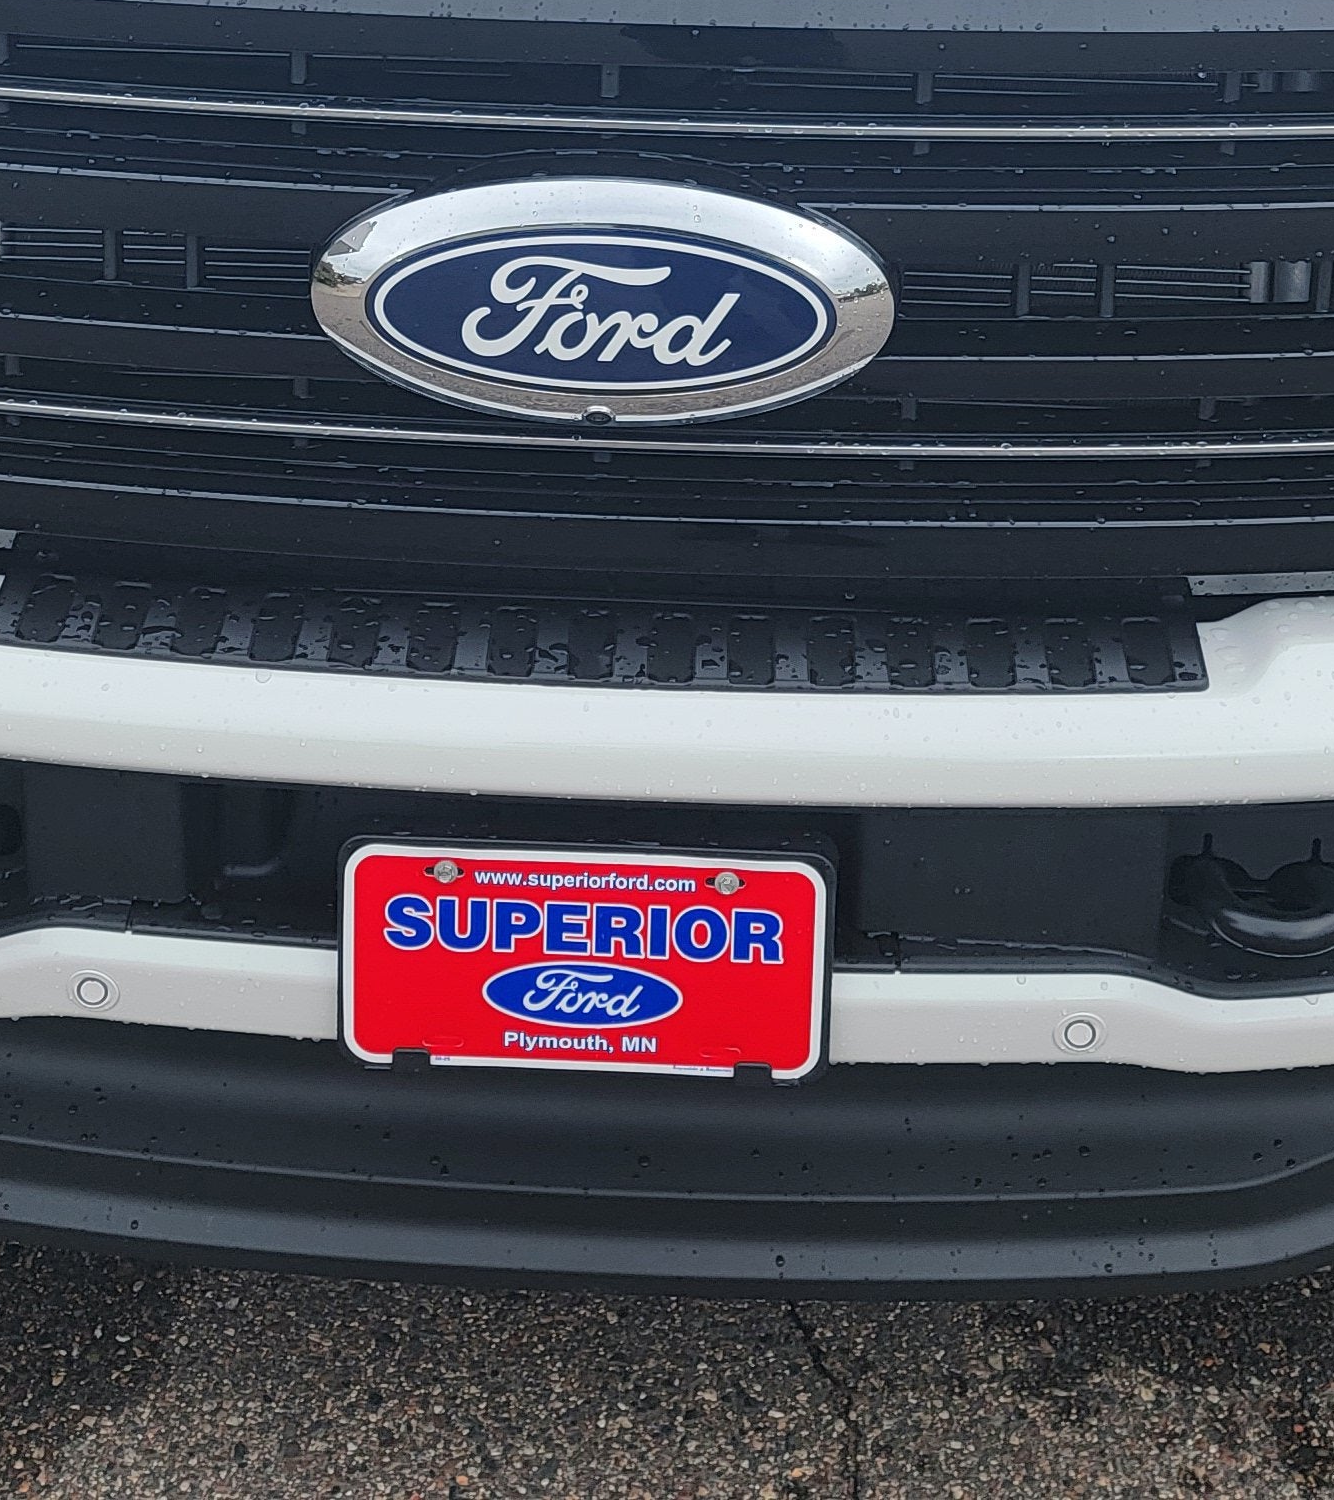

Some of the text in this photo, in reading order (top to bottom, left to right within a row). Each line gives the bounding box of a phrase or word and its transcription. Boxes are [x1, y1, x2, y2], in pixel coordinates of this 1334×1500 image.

[461, 255, 741, 367] Ford
[473, 870, 697, 893] www.superiorford.com
[383, 893, 784, 964] SUPERIOR
[522, 969, 644, 1018] Ford
[504, 1030, 658, 1054] Plymouth, MN
